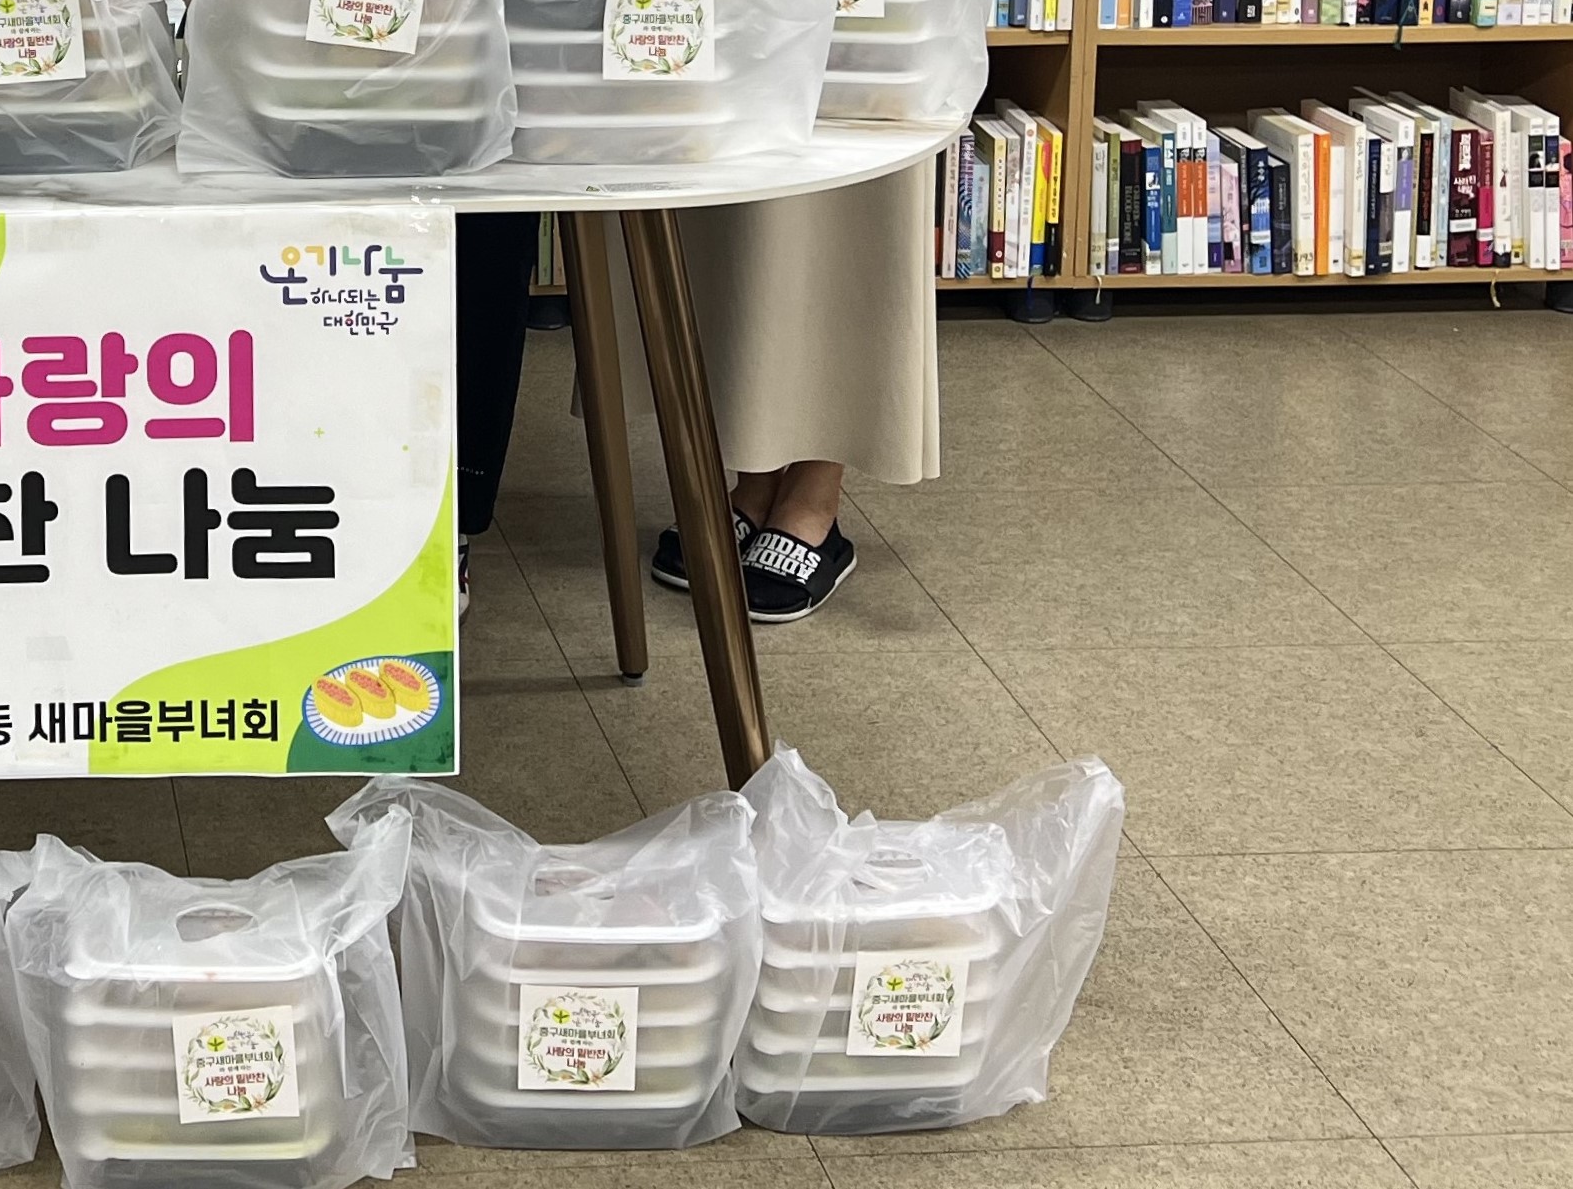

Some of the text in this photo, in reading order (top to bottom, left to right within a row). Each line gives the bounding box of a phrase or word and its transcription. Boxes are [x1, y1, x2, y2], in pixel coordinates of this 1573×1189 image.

[310, 288, 381, 307] 하나되는
[322, 310, 400, 336] 대한민국
[105, 467, 340, 580] 나눔
[27, 697, 280, 744] 새마을부녀회
[876, 1014, 903, 1022] 사랑의
[546, 1047, 574, 1056] 사랑의
[205, 1075, 233, 1086] 사랑의
